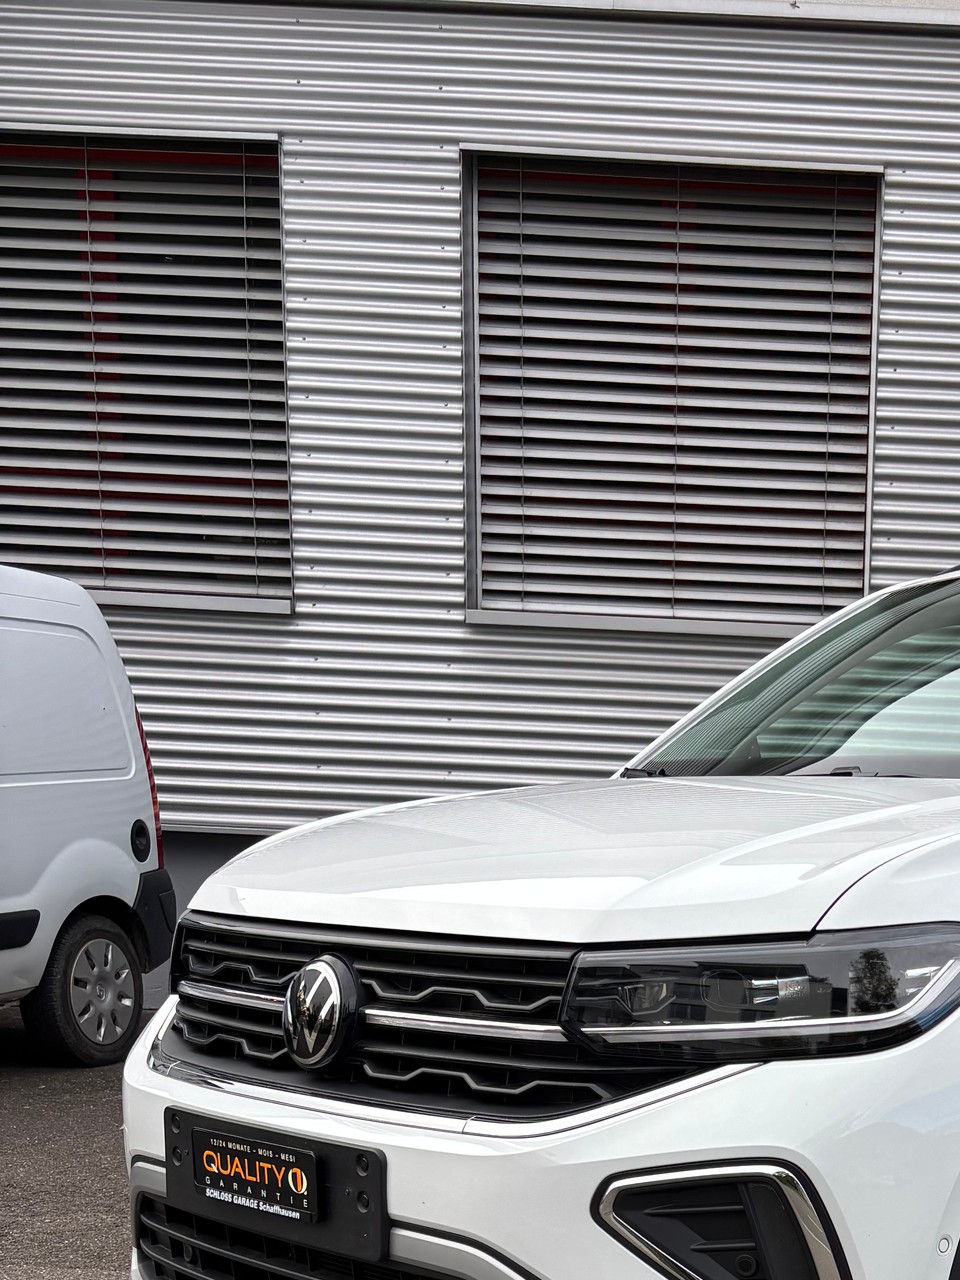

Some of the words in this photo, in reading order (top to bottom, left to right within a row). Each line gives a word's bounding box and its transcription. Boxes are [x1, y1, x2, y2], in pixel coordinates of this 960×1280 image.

[210, 1138, 226, 1148] 12/24
[227, 1140, 251, 1153] MONATE
[257, 1148, 273, 1158] MOIS
[280, 1153, 296, 1162] MESI
[202, 1150, 286, 1188] QUALITY
[205, 1176, 308, 1208] GARANTIE
[205, 1188, 232, 1203] SCHLOSS
[233, 1195, 258, 1209] GARAGE
[258, 1201, 300, 1220] Schaffhausen
